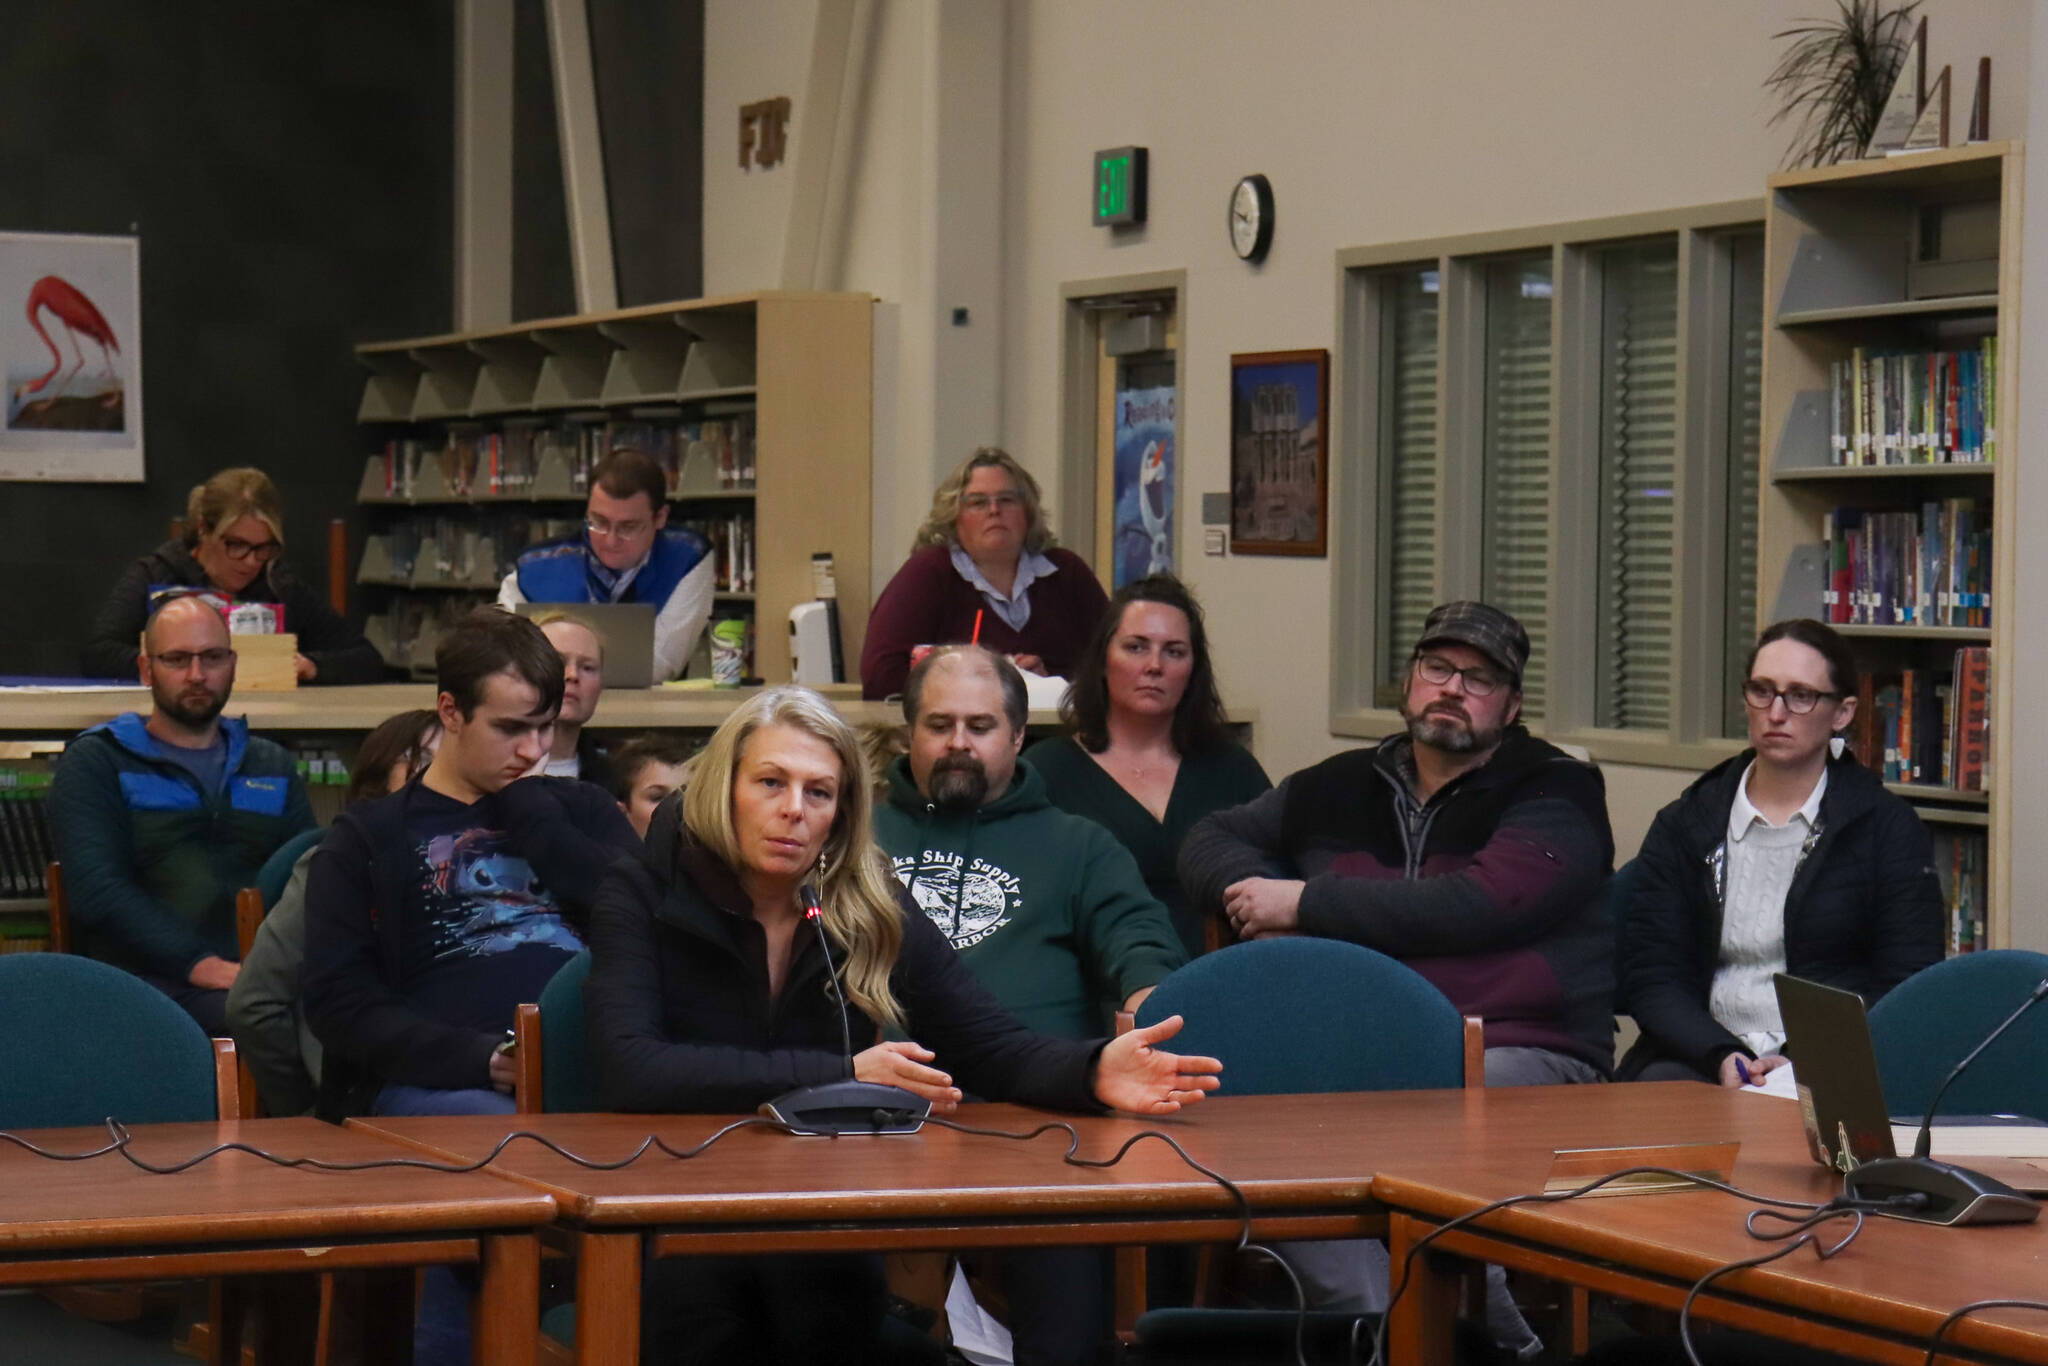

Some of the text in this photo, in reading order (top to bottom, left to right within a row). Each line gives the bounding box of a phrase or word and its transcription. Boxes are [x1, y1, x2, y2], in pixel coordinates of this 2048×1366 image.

[1100, 157, 1129, 217] EXIT
[892, 849, 1020, 894] ka Ship Supply
